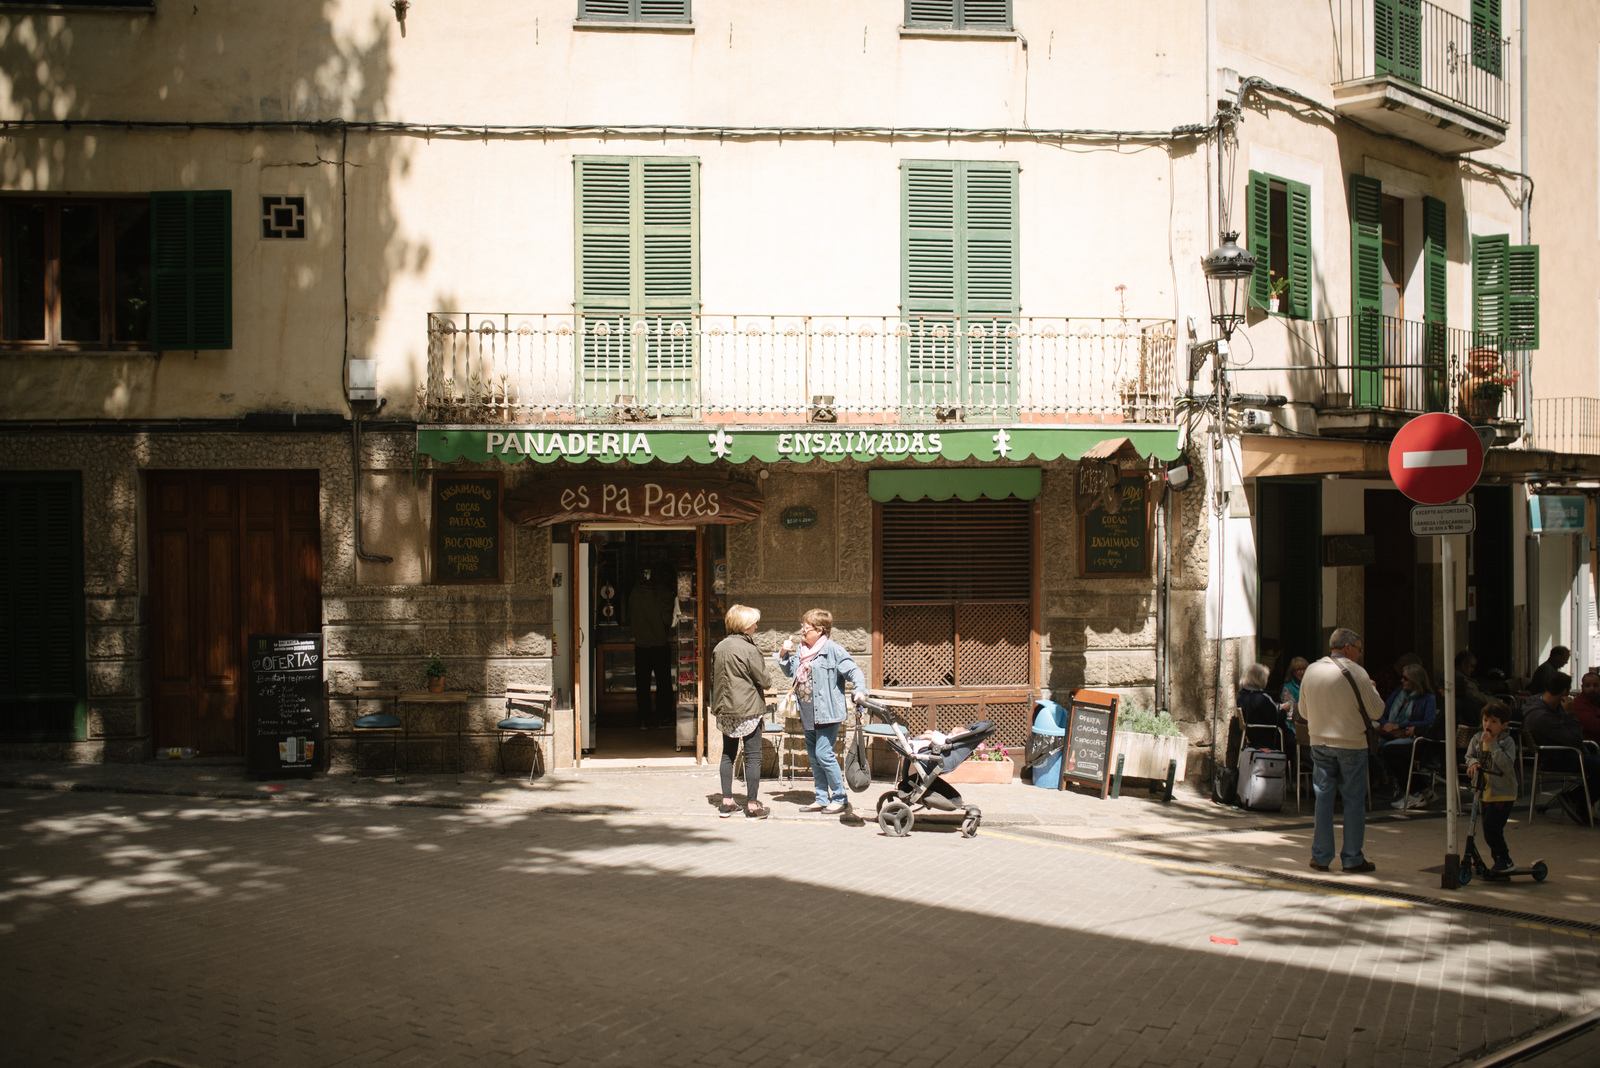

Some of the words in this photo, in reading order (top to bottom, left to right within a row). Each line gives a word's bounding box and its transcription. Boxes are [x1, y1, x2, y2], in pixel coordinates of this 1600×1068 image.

[486, 432, 652, 455] PANADERIA
[777, 431, 943, 455] ENSAIMADAS
[560, 485, 590, 511] es
[602, 484, 632, 514] pa
[262, 652, 312, 670] OFERTA
